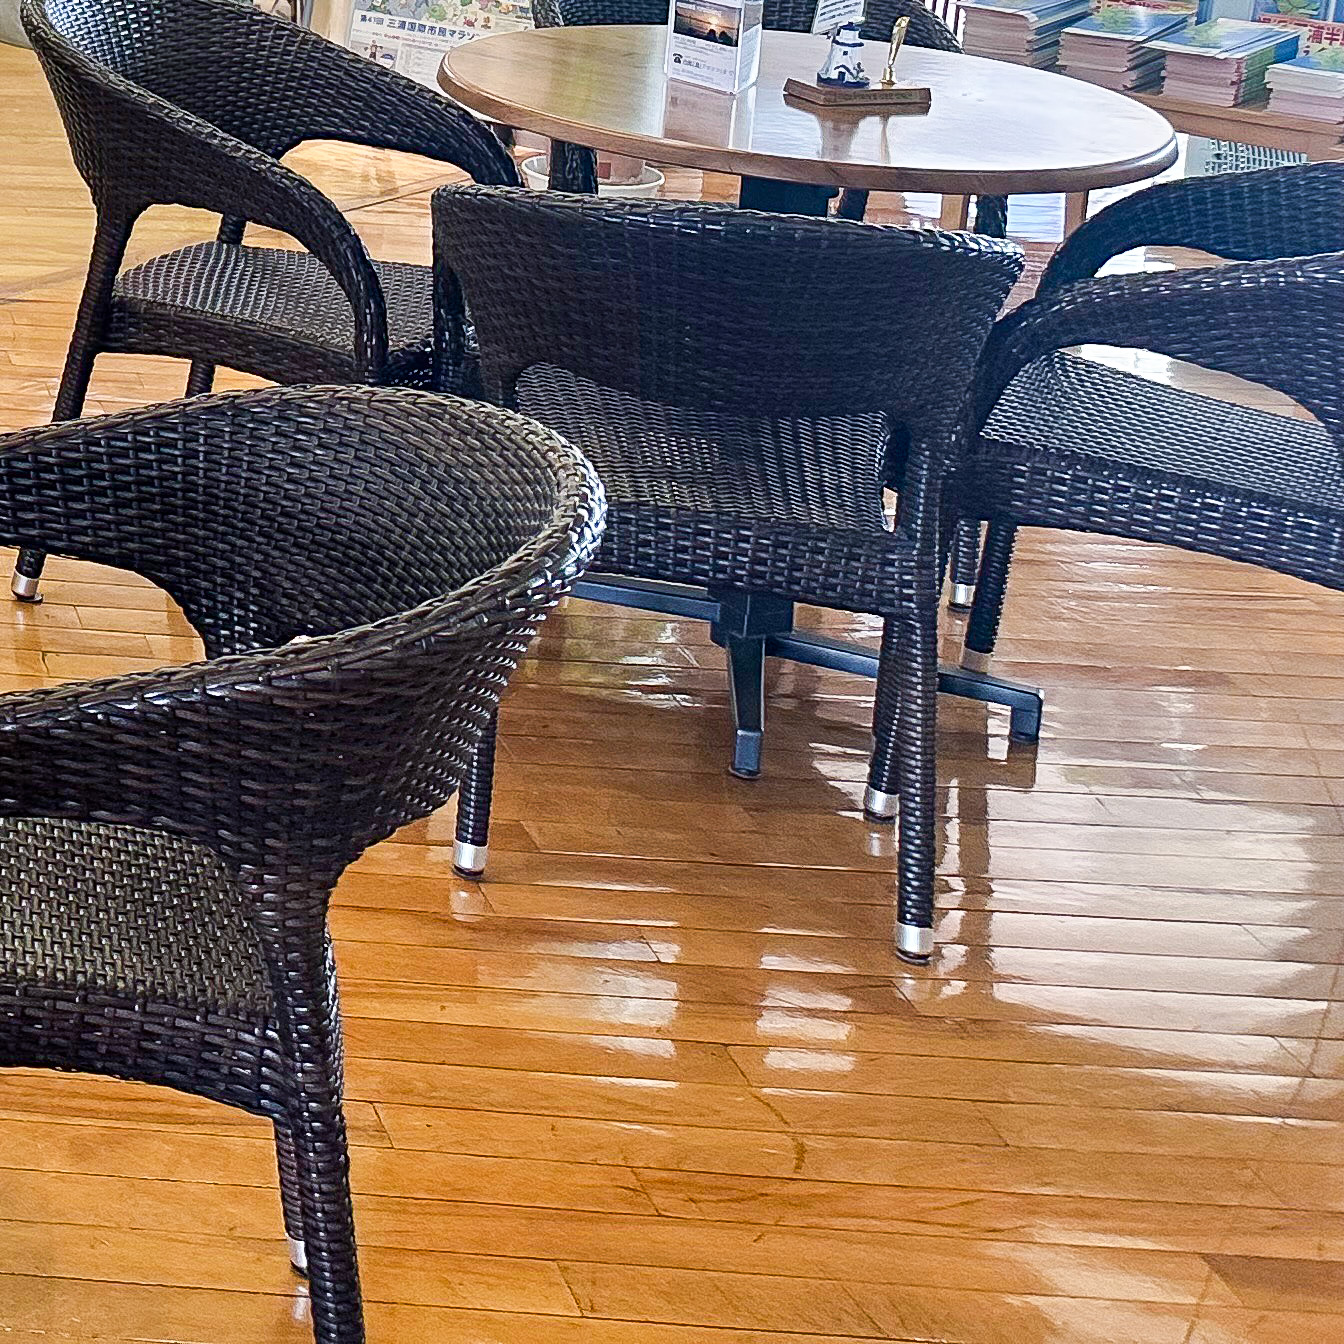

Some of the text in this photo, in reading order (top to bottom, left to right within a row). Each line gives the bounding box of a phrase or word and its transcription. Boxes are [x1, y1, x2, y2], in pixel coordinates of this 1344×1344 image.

[386, 18, 480, 41] 三浦国際市民マラソ
